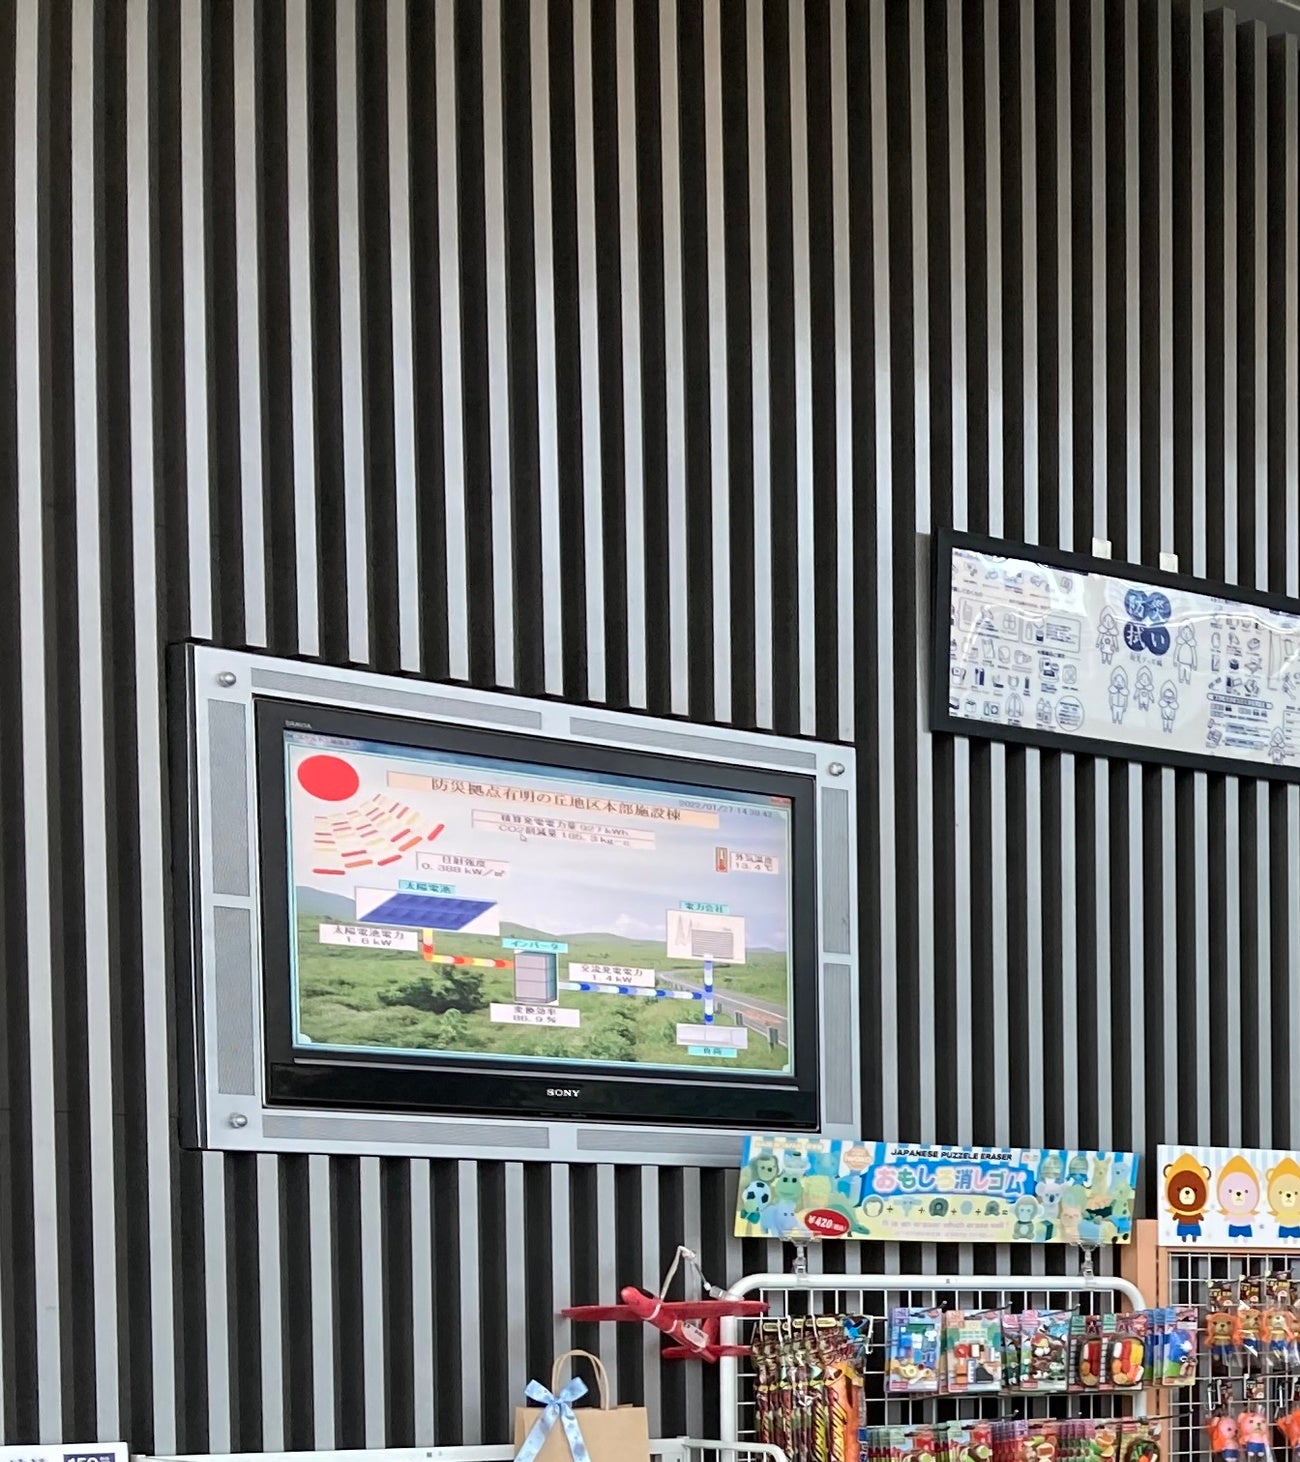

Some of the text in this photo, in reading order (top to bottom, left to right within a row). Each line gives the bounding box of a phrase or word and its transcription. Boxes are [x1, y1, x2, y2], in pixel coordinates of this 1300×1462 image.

[546, 1088, 581, 1098] SONY
[890, 1147, 939, 1159] JAPANESE
[980, 1152, 1013, 1162] ERASER
[872, 1164, 1027, 1196] おもしろ消しゴム
